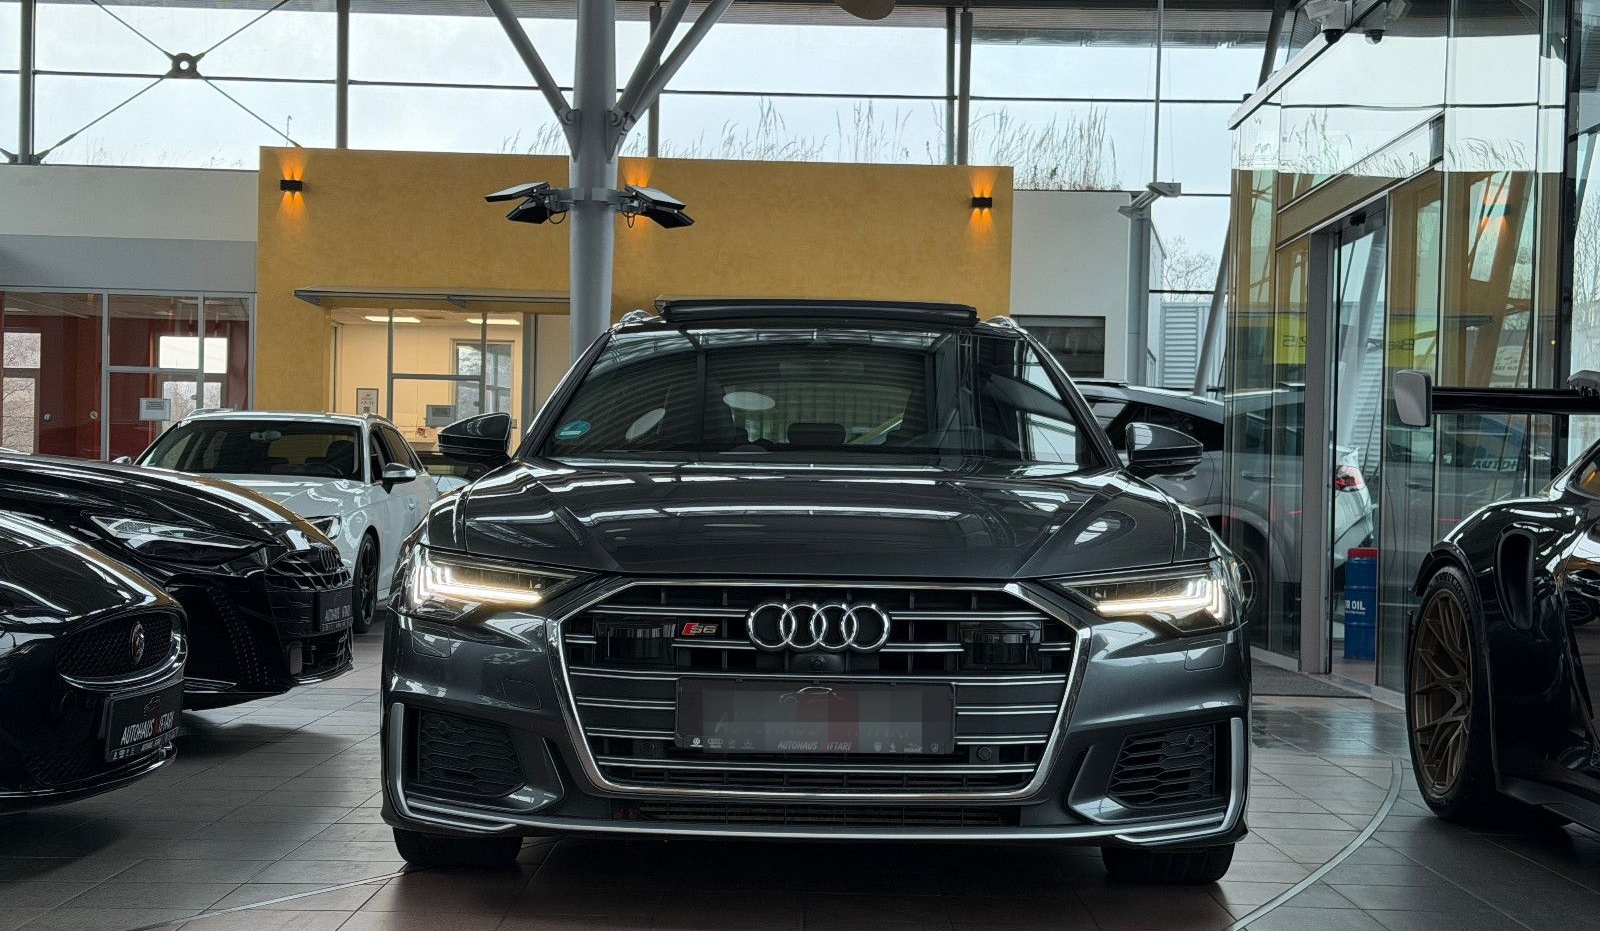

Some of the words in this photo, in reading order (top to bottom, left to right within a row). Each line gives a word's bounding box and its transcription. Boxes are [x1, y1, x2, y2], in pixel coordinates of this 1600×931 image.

[1351, 600, 1366, 611] OIL
[687, 623, 718, 635] S6
[120, 718, 156, 746] AUTOHAUS
[777, 740, 818, 750] AUTOHAUS
